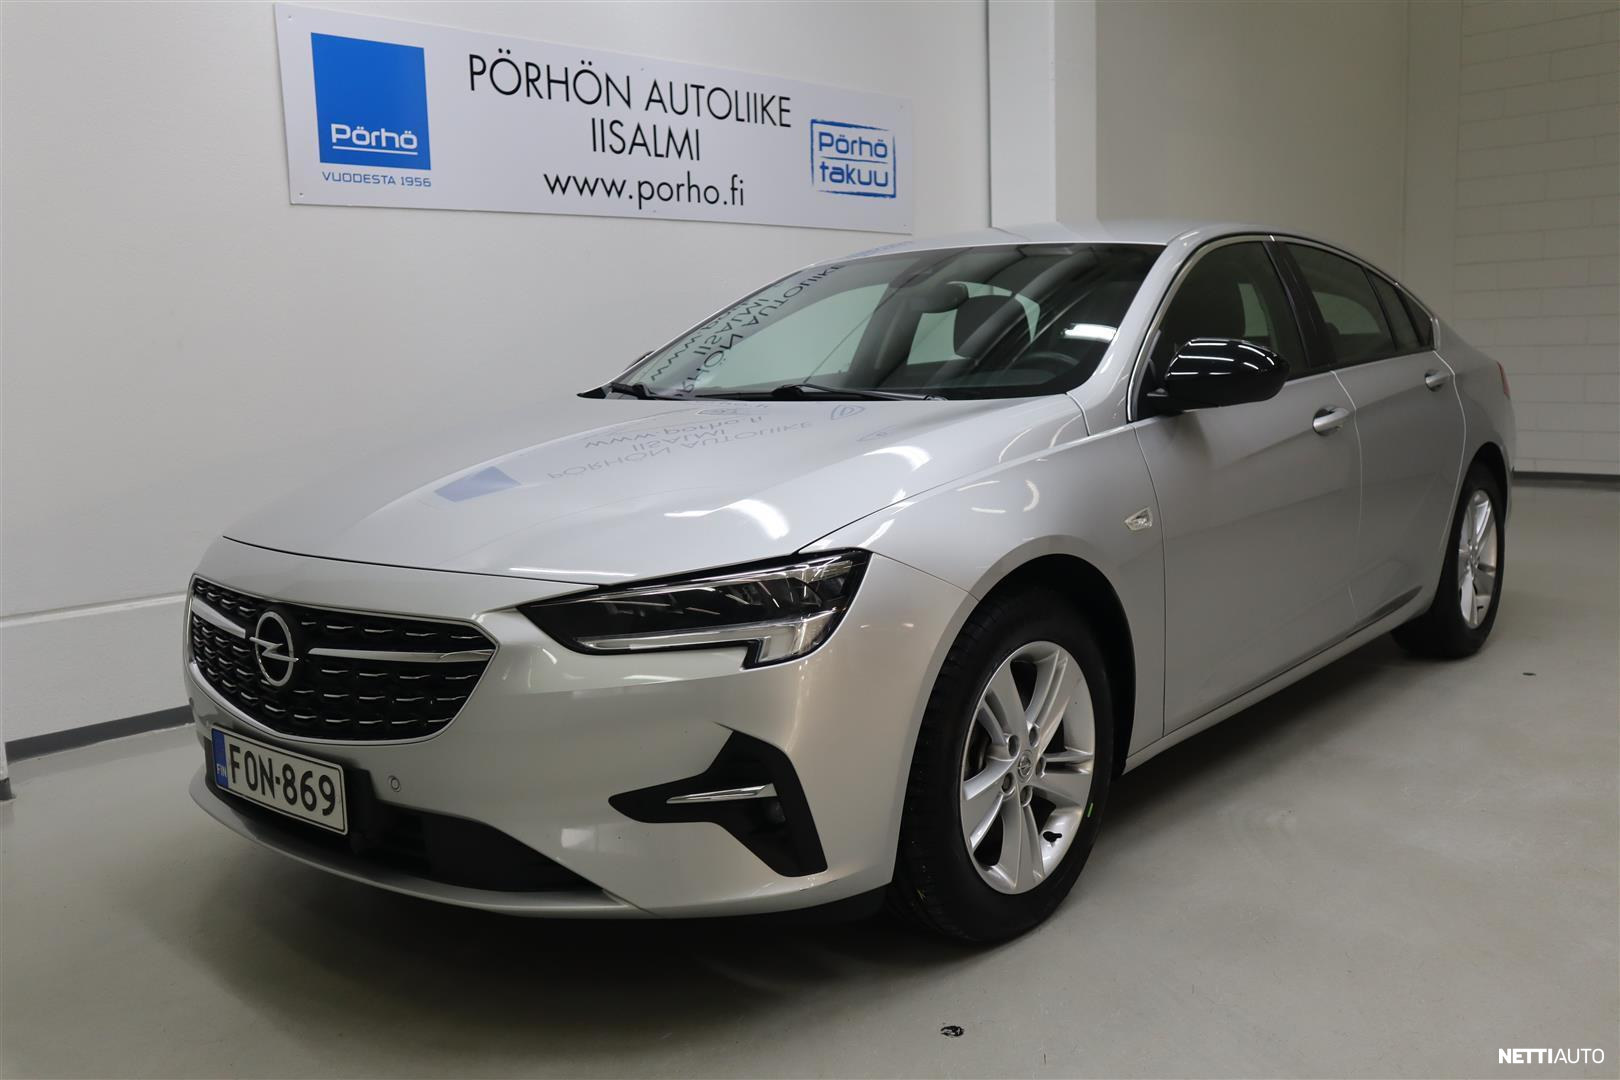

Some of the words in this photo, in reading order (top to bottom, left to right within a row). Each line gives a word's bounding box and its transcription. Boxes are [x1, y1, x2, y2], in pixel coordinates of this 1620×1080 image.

[469, 48, 631, 109] PÖRHÖN
[645, 79, 792, 128] AUTOLIIKE
[331, 123, 418, 149] Pörhö
[592, 117, 700, 161] IISALMI
[818, 131, 888, 159] Pörhö
[322, 171, 396, 185] VUODESTA
[401, 176, 432, 187] 1956
[819, 161, 889, 187] takuu
[543, 170, 744, 210] www.porho.fi
[216, 763, 227, 778] FIN
